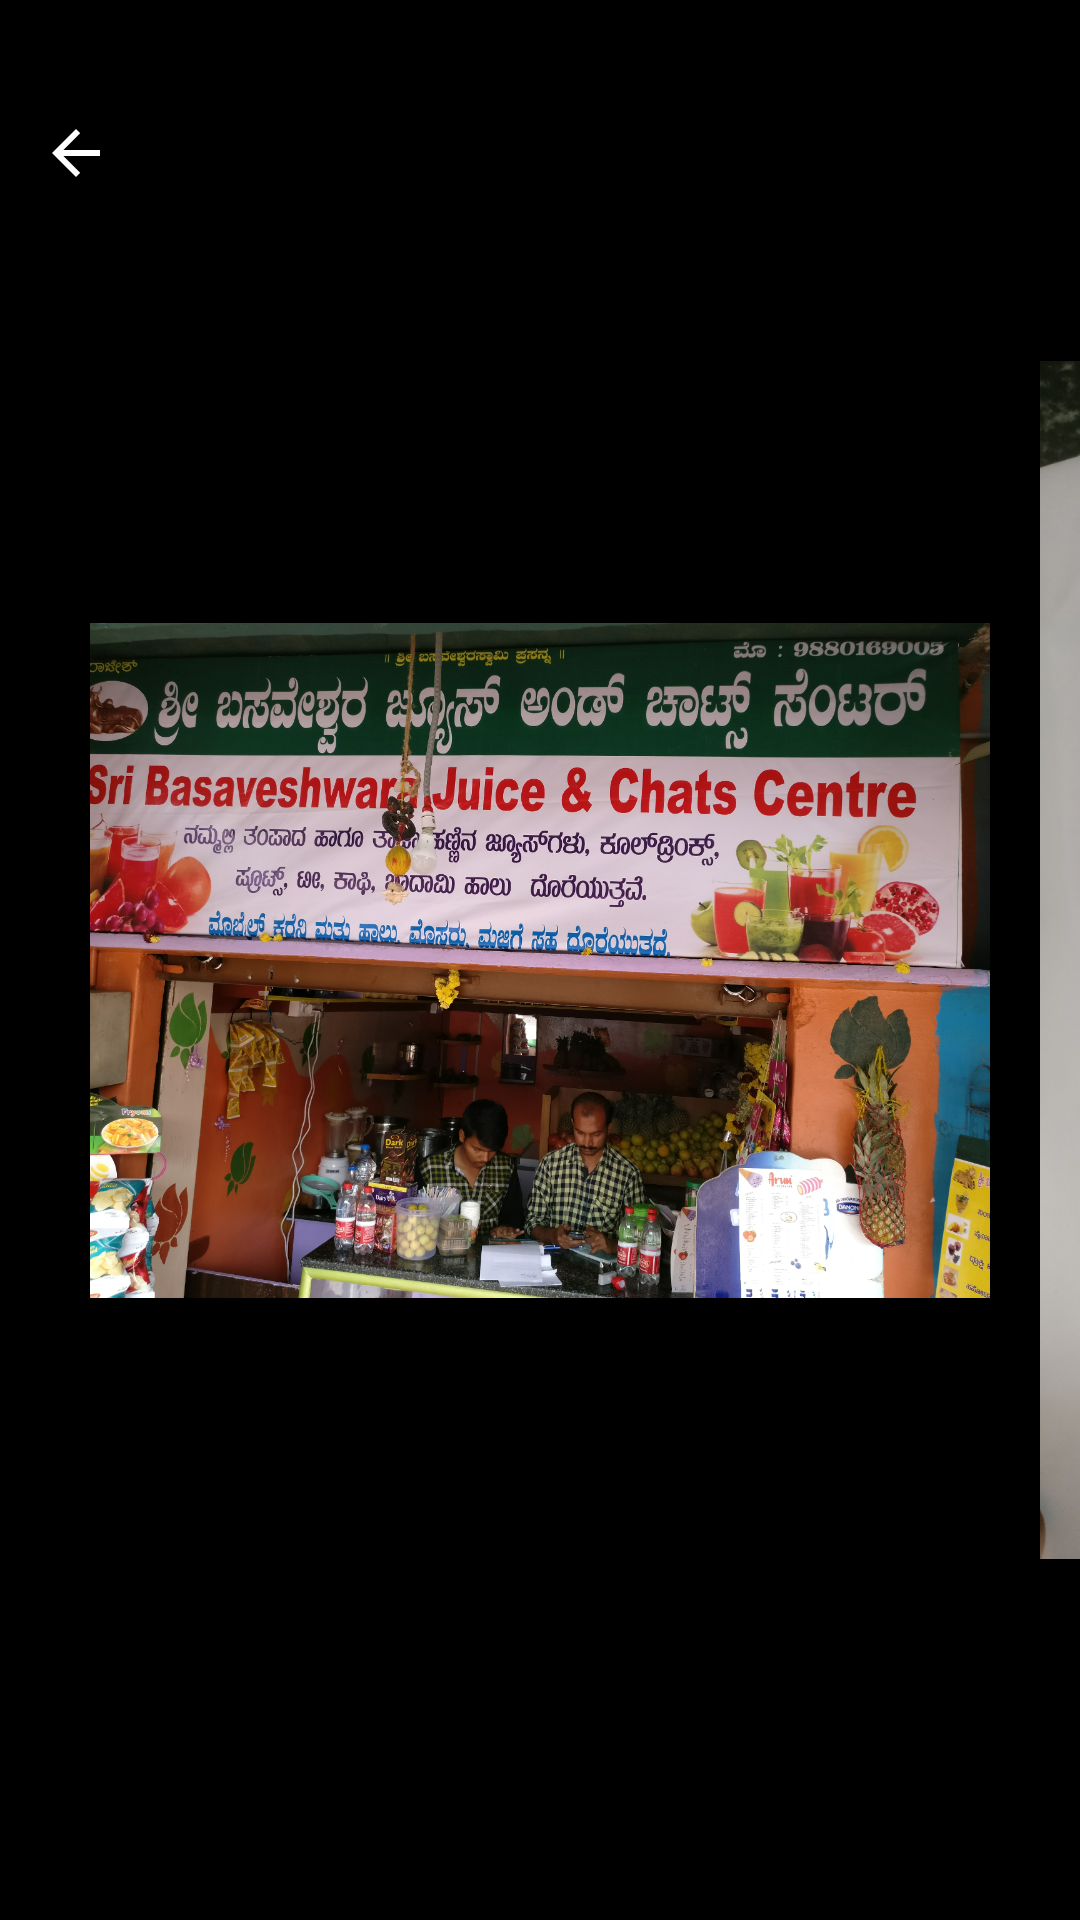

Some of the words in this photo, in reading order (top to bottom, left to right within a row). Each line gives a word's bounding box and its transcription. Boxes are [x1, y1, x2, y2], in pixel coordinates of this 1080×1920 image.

[515, 648, 552, 665] ಪ್ರಸನ್ನ
[153, 680, 199, 746] ಶ್ರೀ
[215, 676, 369, 754] ಬಸವೇಶ್ವರ
[385, 674, 501, 755] ಜ್ಯೂಸ್
[520, 672, 625, 727] ಅಂಡ್
[645, 670, 752, 750] ಚಾಟ್ಸ್
[773, 668, 927, 727] ಸೆಂಟರ್
[90, 764, 134, 807] Sri
[144, 764, 419, 809] Basaveshwara
[432, 766, 545, 812] Juice
[561, 766, 593, 813] &
[609, 767, 737, 816] Chats
[753, 768, 917, 819] Centre
[183, 824, 236, 854] ನಮ್ಮಲ್ಲಿ
[243, 825, 307, 847] ತಂಪಾದ
[314, 826, 364, 848] ಹಾಗೂ
[296, 870, 325, 892] ಟೀ,
[333, 870, 376, 896] ಕಾಫಿ,
[464, 876, 512, 896] ಹಾಲು
[530, 873, 647, 908] ದೊರೆಯುತ್ತವೆ.
[531, 924, 559, 951] ಸಹ
[385, 1138, 404, 1146] Dark
[768, 1171, 793, 1187] Arun
[838, 1203, 860, 1212] DANON
